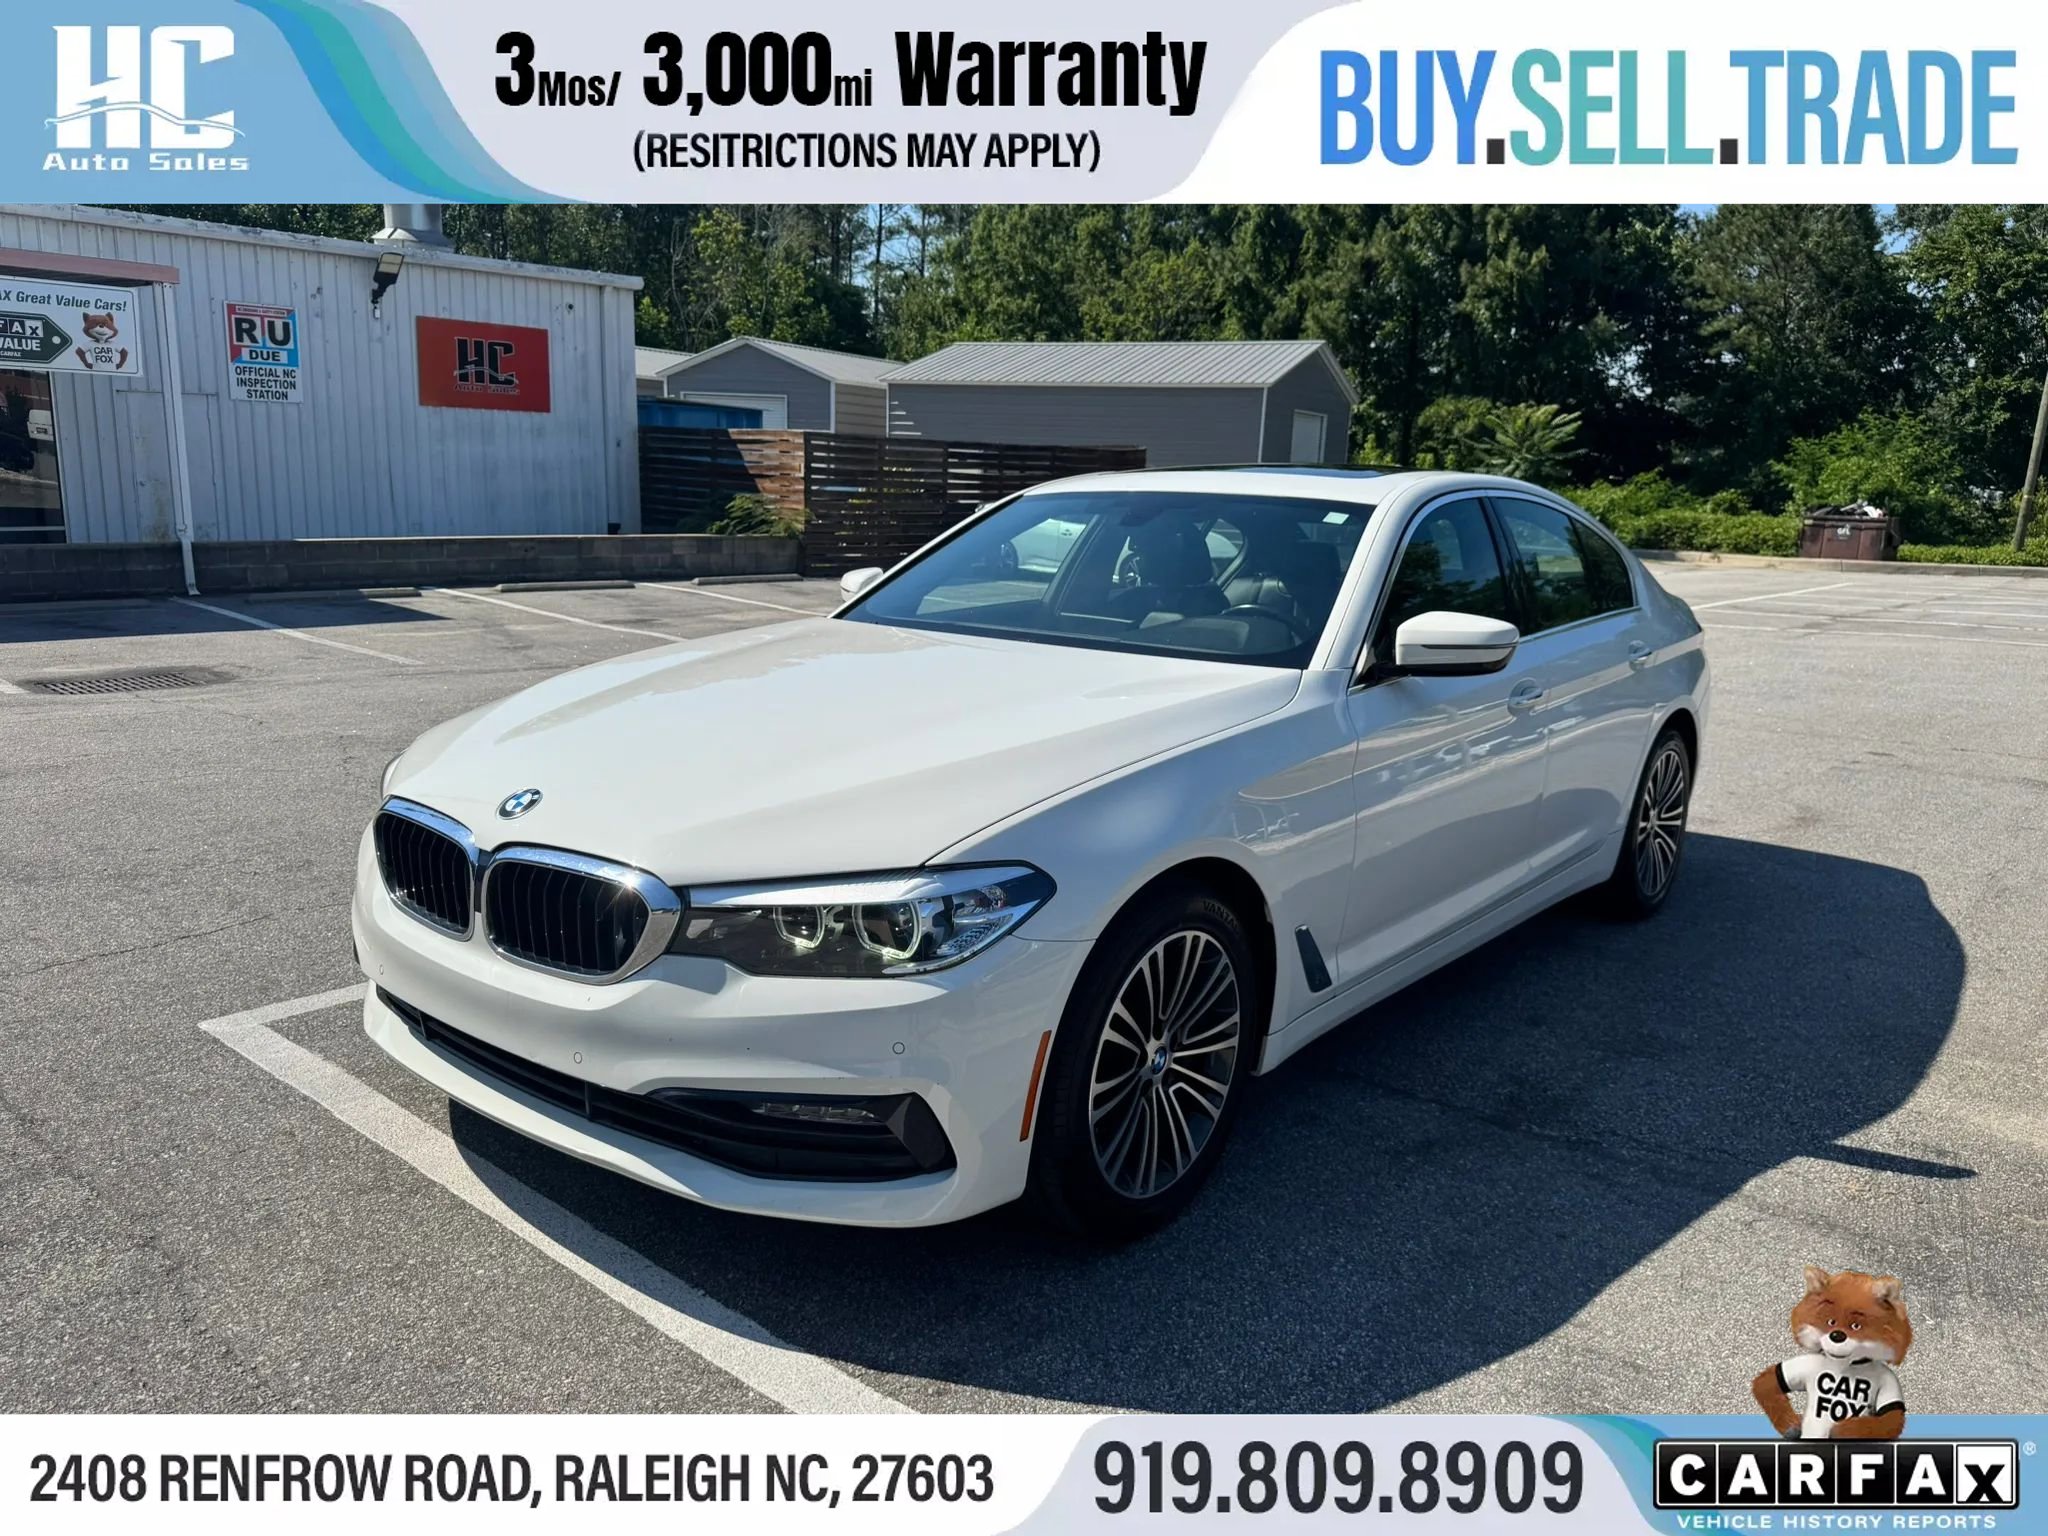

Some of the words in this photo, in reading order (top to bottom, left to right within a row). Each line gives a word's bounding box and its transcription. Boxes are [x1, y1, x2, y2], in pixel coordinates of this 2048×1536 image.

[16, 291, 52, 305] Great
[56, 294, 91, 309] Value
[94, 298, 127, 312] Cars!
[93, 346, 114, 356] CAR
[248, 349, 281, 362] DUE
[95, 355, 114, 364] FOX
[454, 336, 516, 387] HC
[234, 366, 280, 378] OFFICIAL
[282, 369, 297, 379] NC
[236, 377, 297, 390] INSPECTION
[246, 388, 289, 400] STATION
